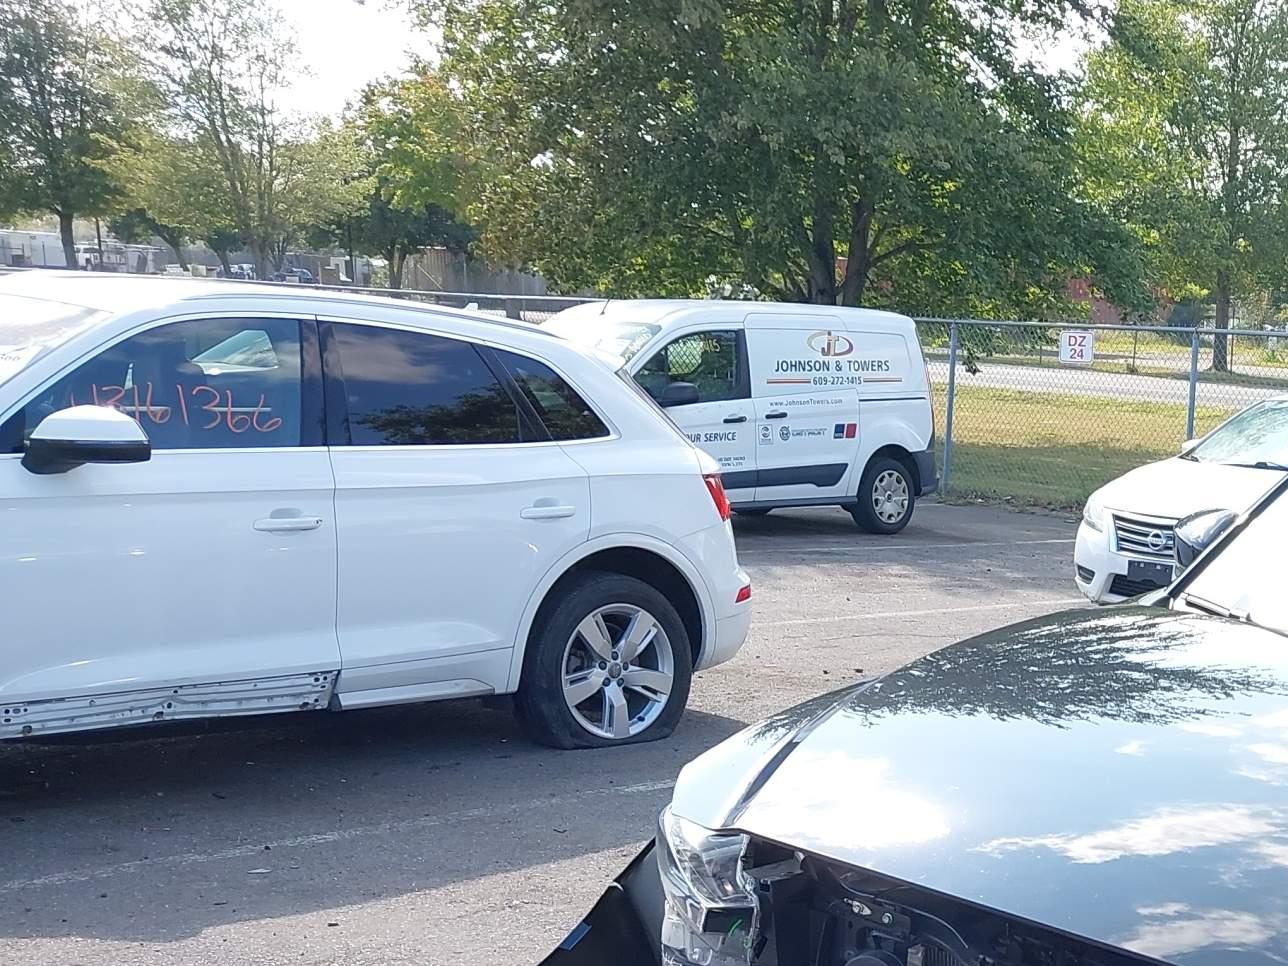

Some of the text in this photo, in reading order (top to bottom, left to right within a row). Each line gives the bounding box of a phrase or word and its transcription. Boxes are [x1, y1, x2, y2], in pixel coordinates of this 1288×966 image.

[1068, 335, 1087, 347] DZ
[1070, 348, 1084, 360] 24
[775, 360, 890, 372] JOHNSON & TOWERS
[813, 376, 862, 386] 609-272-1415
[769, 398, 843, 407] www.JohnsonTowers.com
[704, 431, 737, 442] SERVICE
